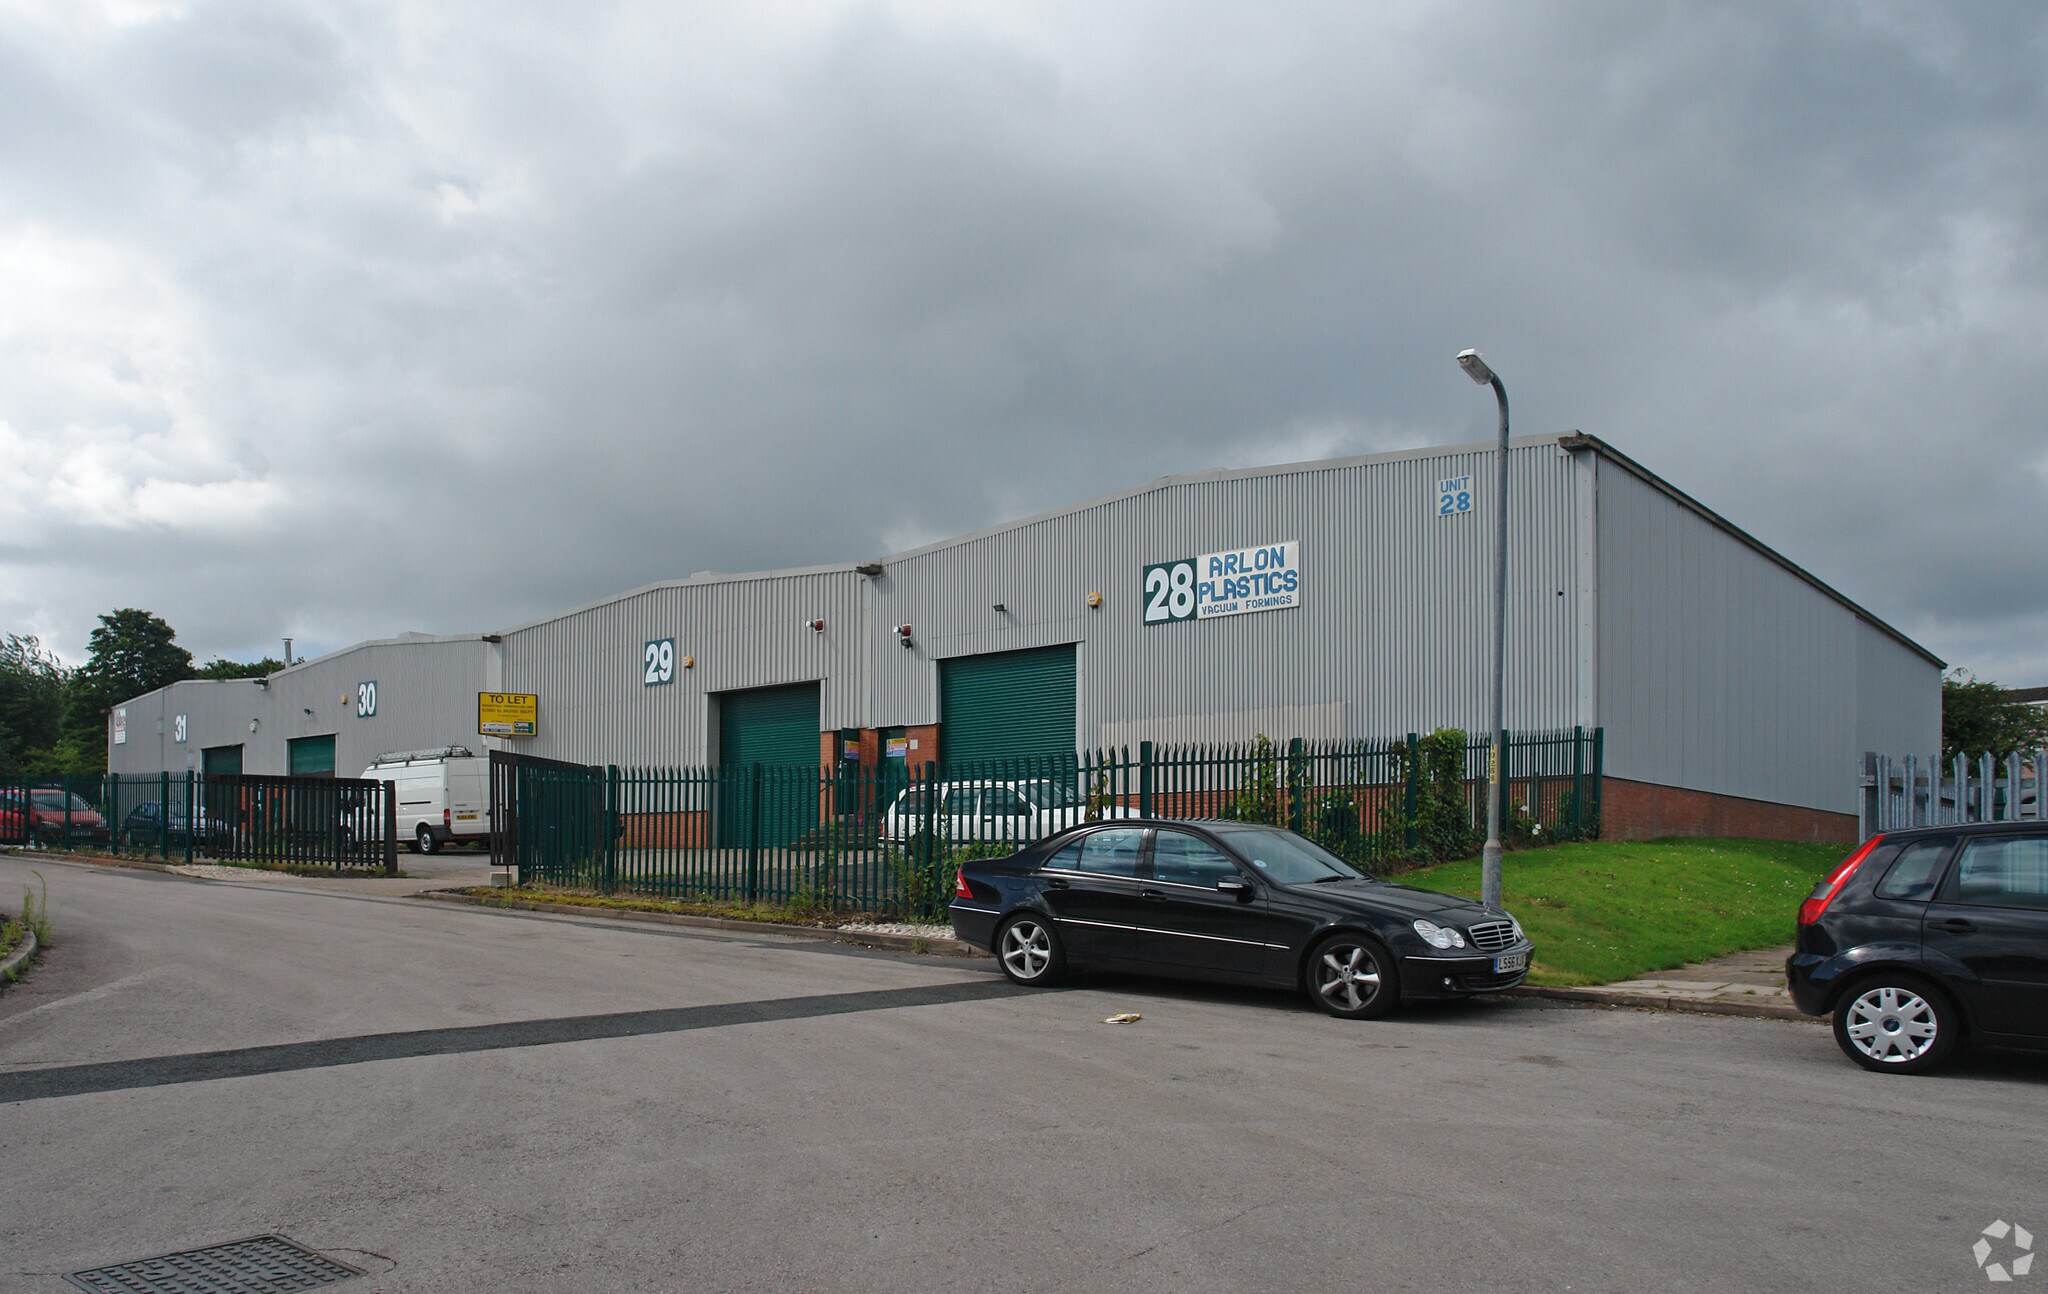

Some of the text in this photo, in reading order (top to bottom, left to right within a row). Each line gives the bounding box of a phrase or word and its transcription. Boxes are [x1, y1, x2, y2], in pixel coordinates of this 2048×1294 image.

[1440, 476, 1469, 493] UNIT
[1440, 491, 1470, 515] 28
[1209, 546, 1285, 578] ARLON
[1145, 563, 1195, 622] 28
[1198, 569, 1298, 604] PLASTICS
[1201, 594, 1292, 615] VACUUM FORMINGS
[645, 641, 673, 683] 29
[358, 682, 376, 716] 30
[489, 695, 528, 704] TO LET
[175, 714, 186, 742] 31
